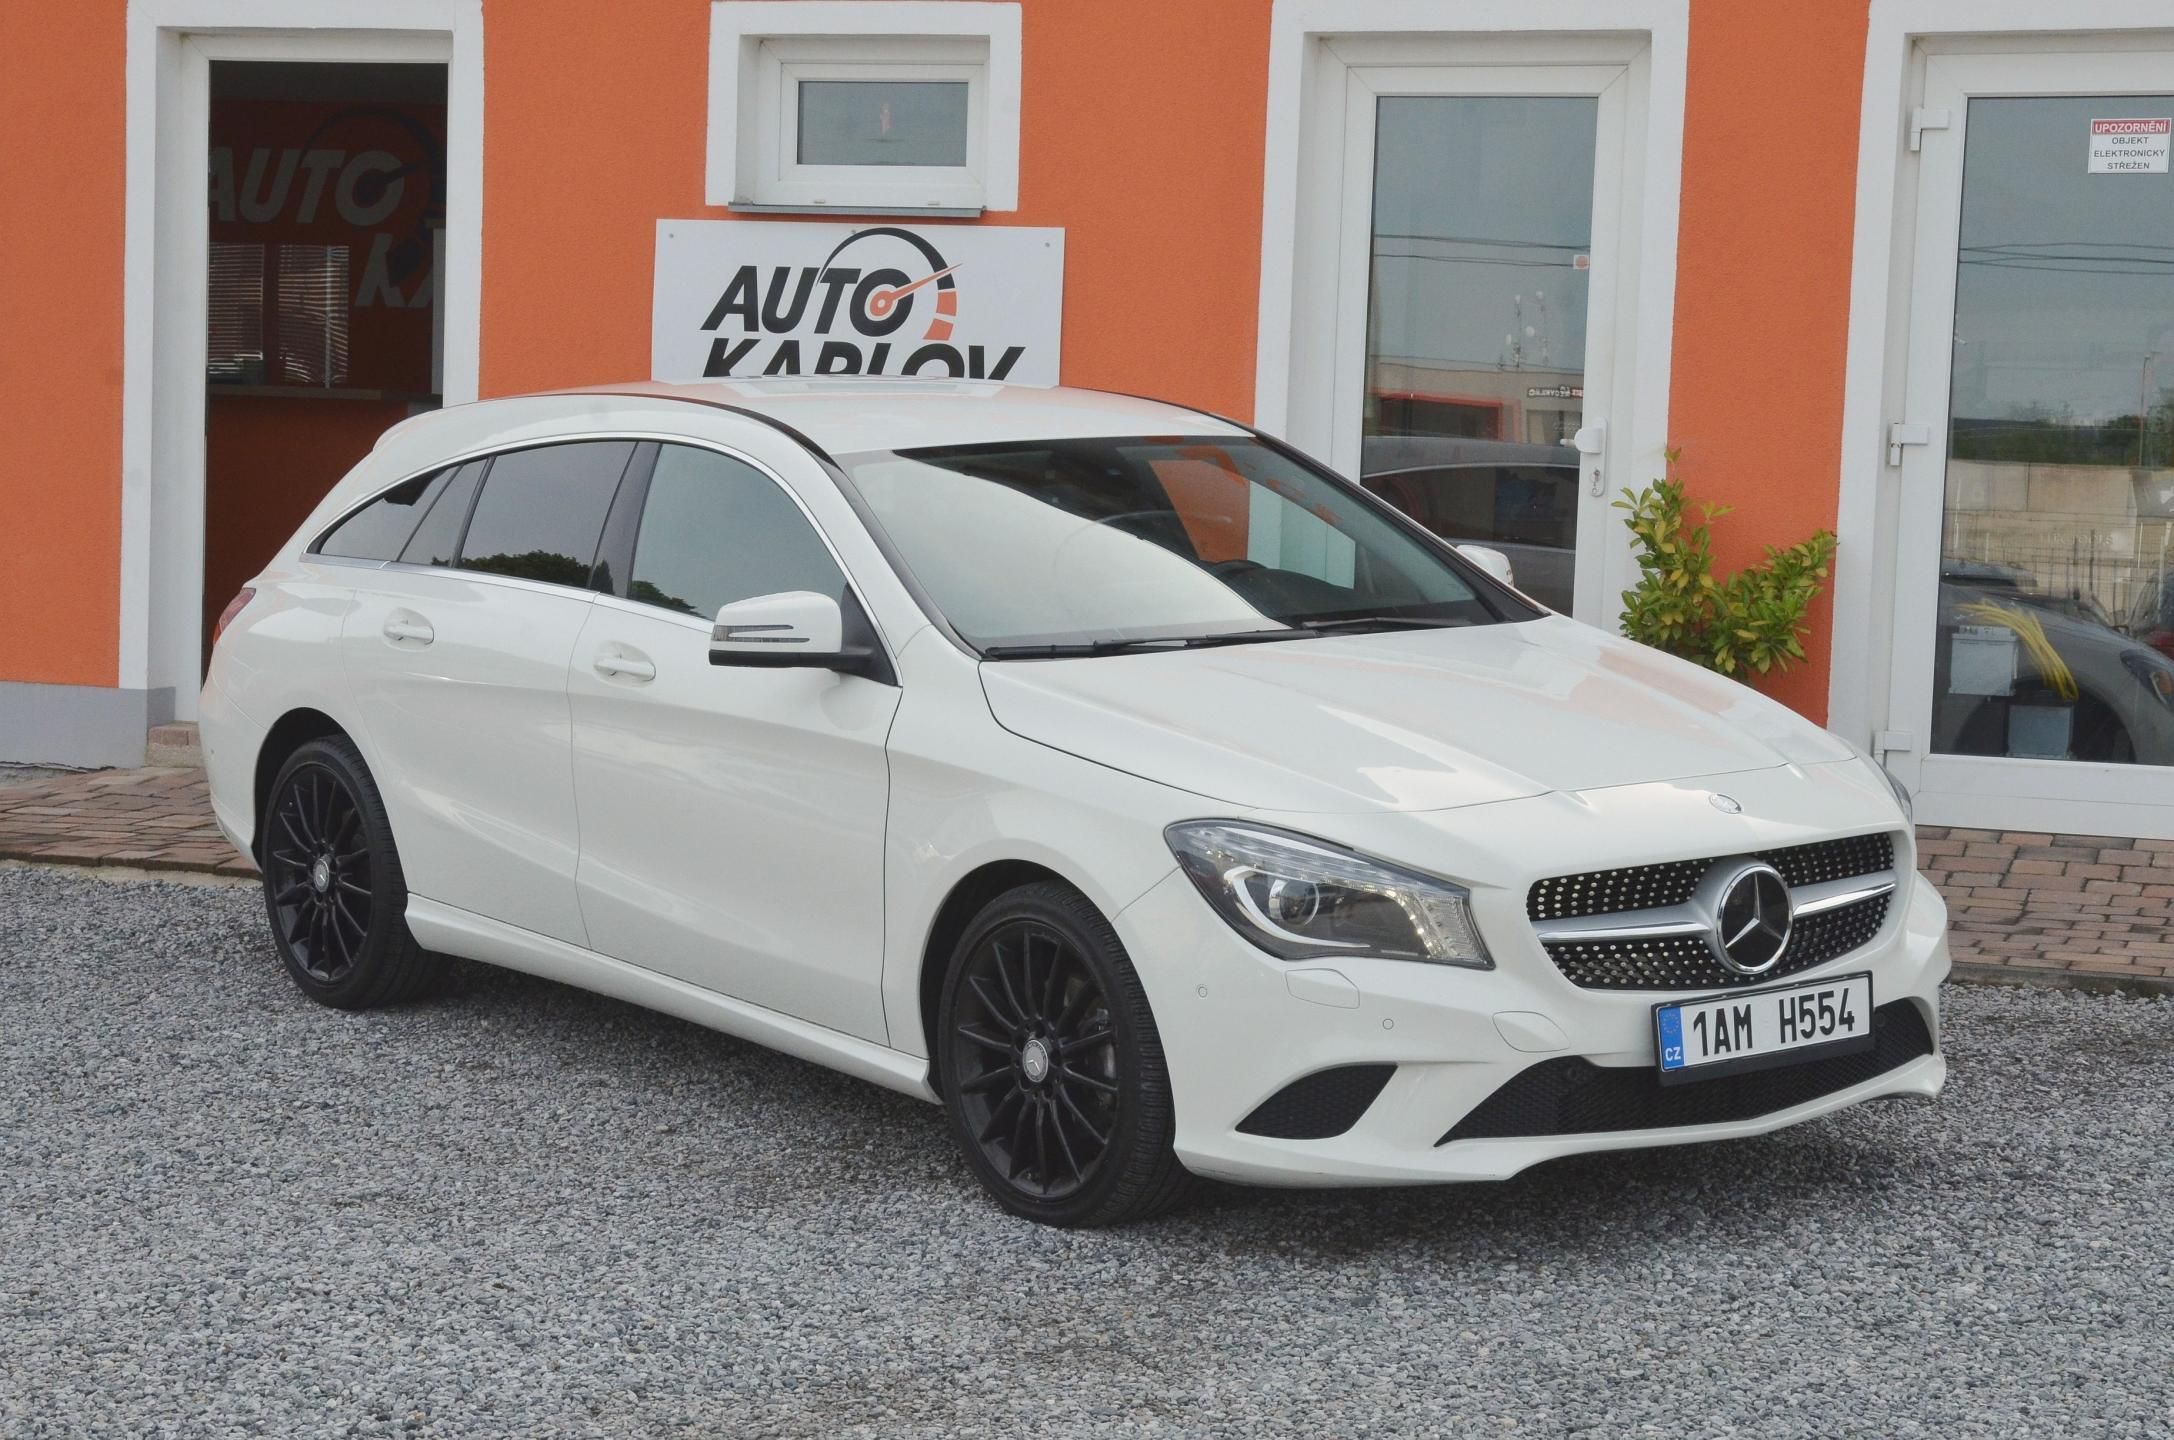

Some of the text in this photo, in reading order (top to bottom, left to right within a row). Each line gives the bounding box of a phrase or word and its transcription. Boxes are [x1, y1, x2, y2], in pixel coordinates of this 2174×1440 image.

[2095, 121, 2167, 133] UPOZORNĚNÍ
[2111, 136, 2149, 145] OBJEKT
[2094, 149, 2165, 158] ELEKTRONICKY
[2107, 160, 2150, 170] STŘEŽEN
[700, 265, 914, 337] AUTO
[1693, 987, 1855, 1057] 1AM H554
[1664, 1046, 1682, 1062] CZ
